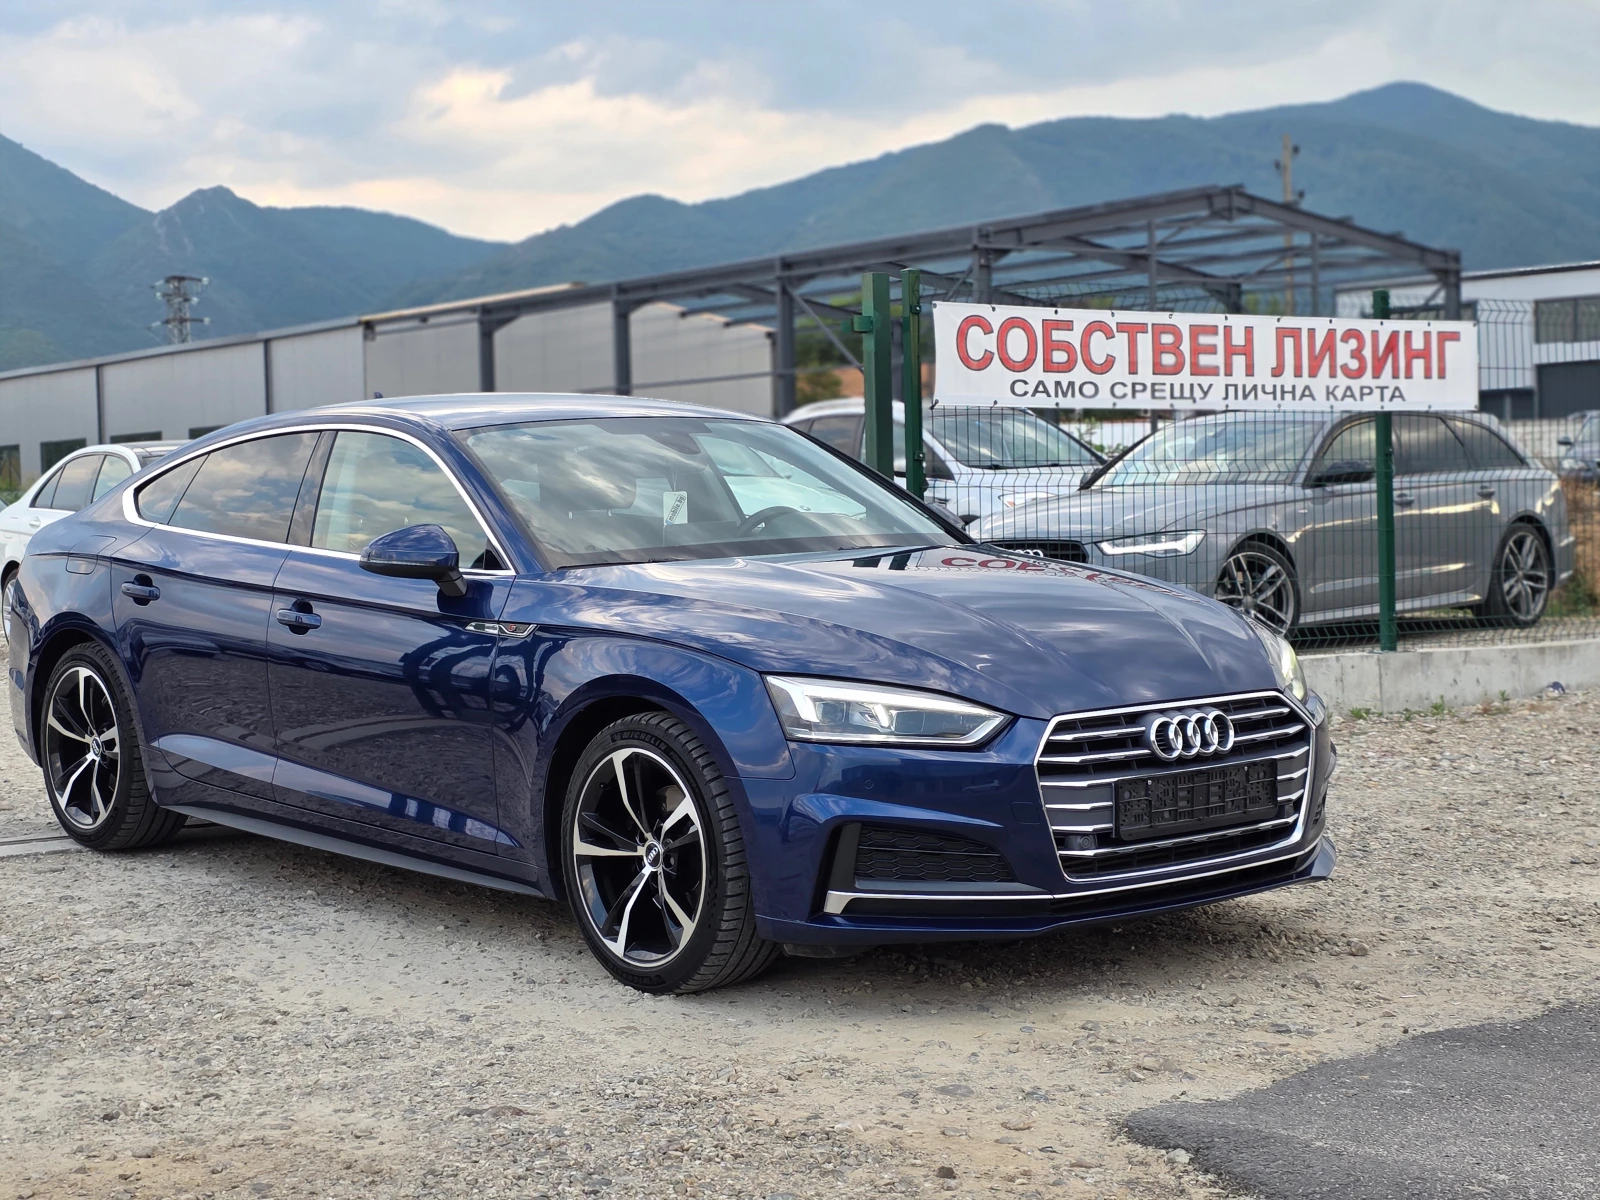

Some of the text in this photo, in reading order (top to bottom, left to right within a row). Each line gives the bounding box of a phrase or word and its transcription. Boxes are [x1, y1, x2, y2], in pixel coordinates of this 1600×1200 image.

[956, 315, 1461, 379] СОБСТВЕН ЛИЗИНГ
[1009, 379, 1406, 404] САМО СРЕЩУ ЛИЧНА КАРТА
[622, 731, 667, 751] MICHELIN
